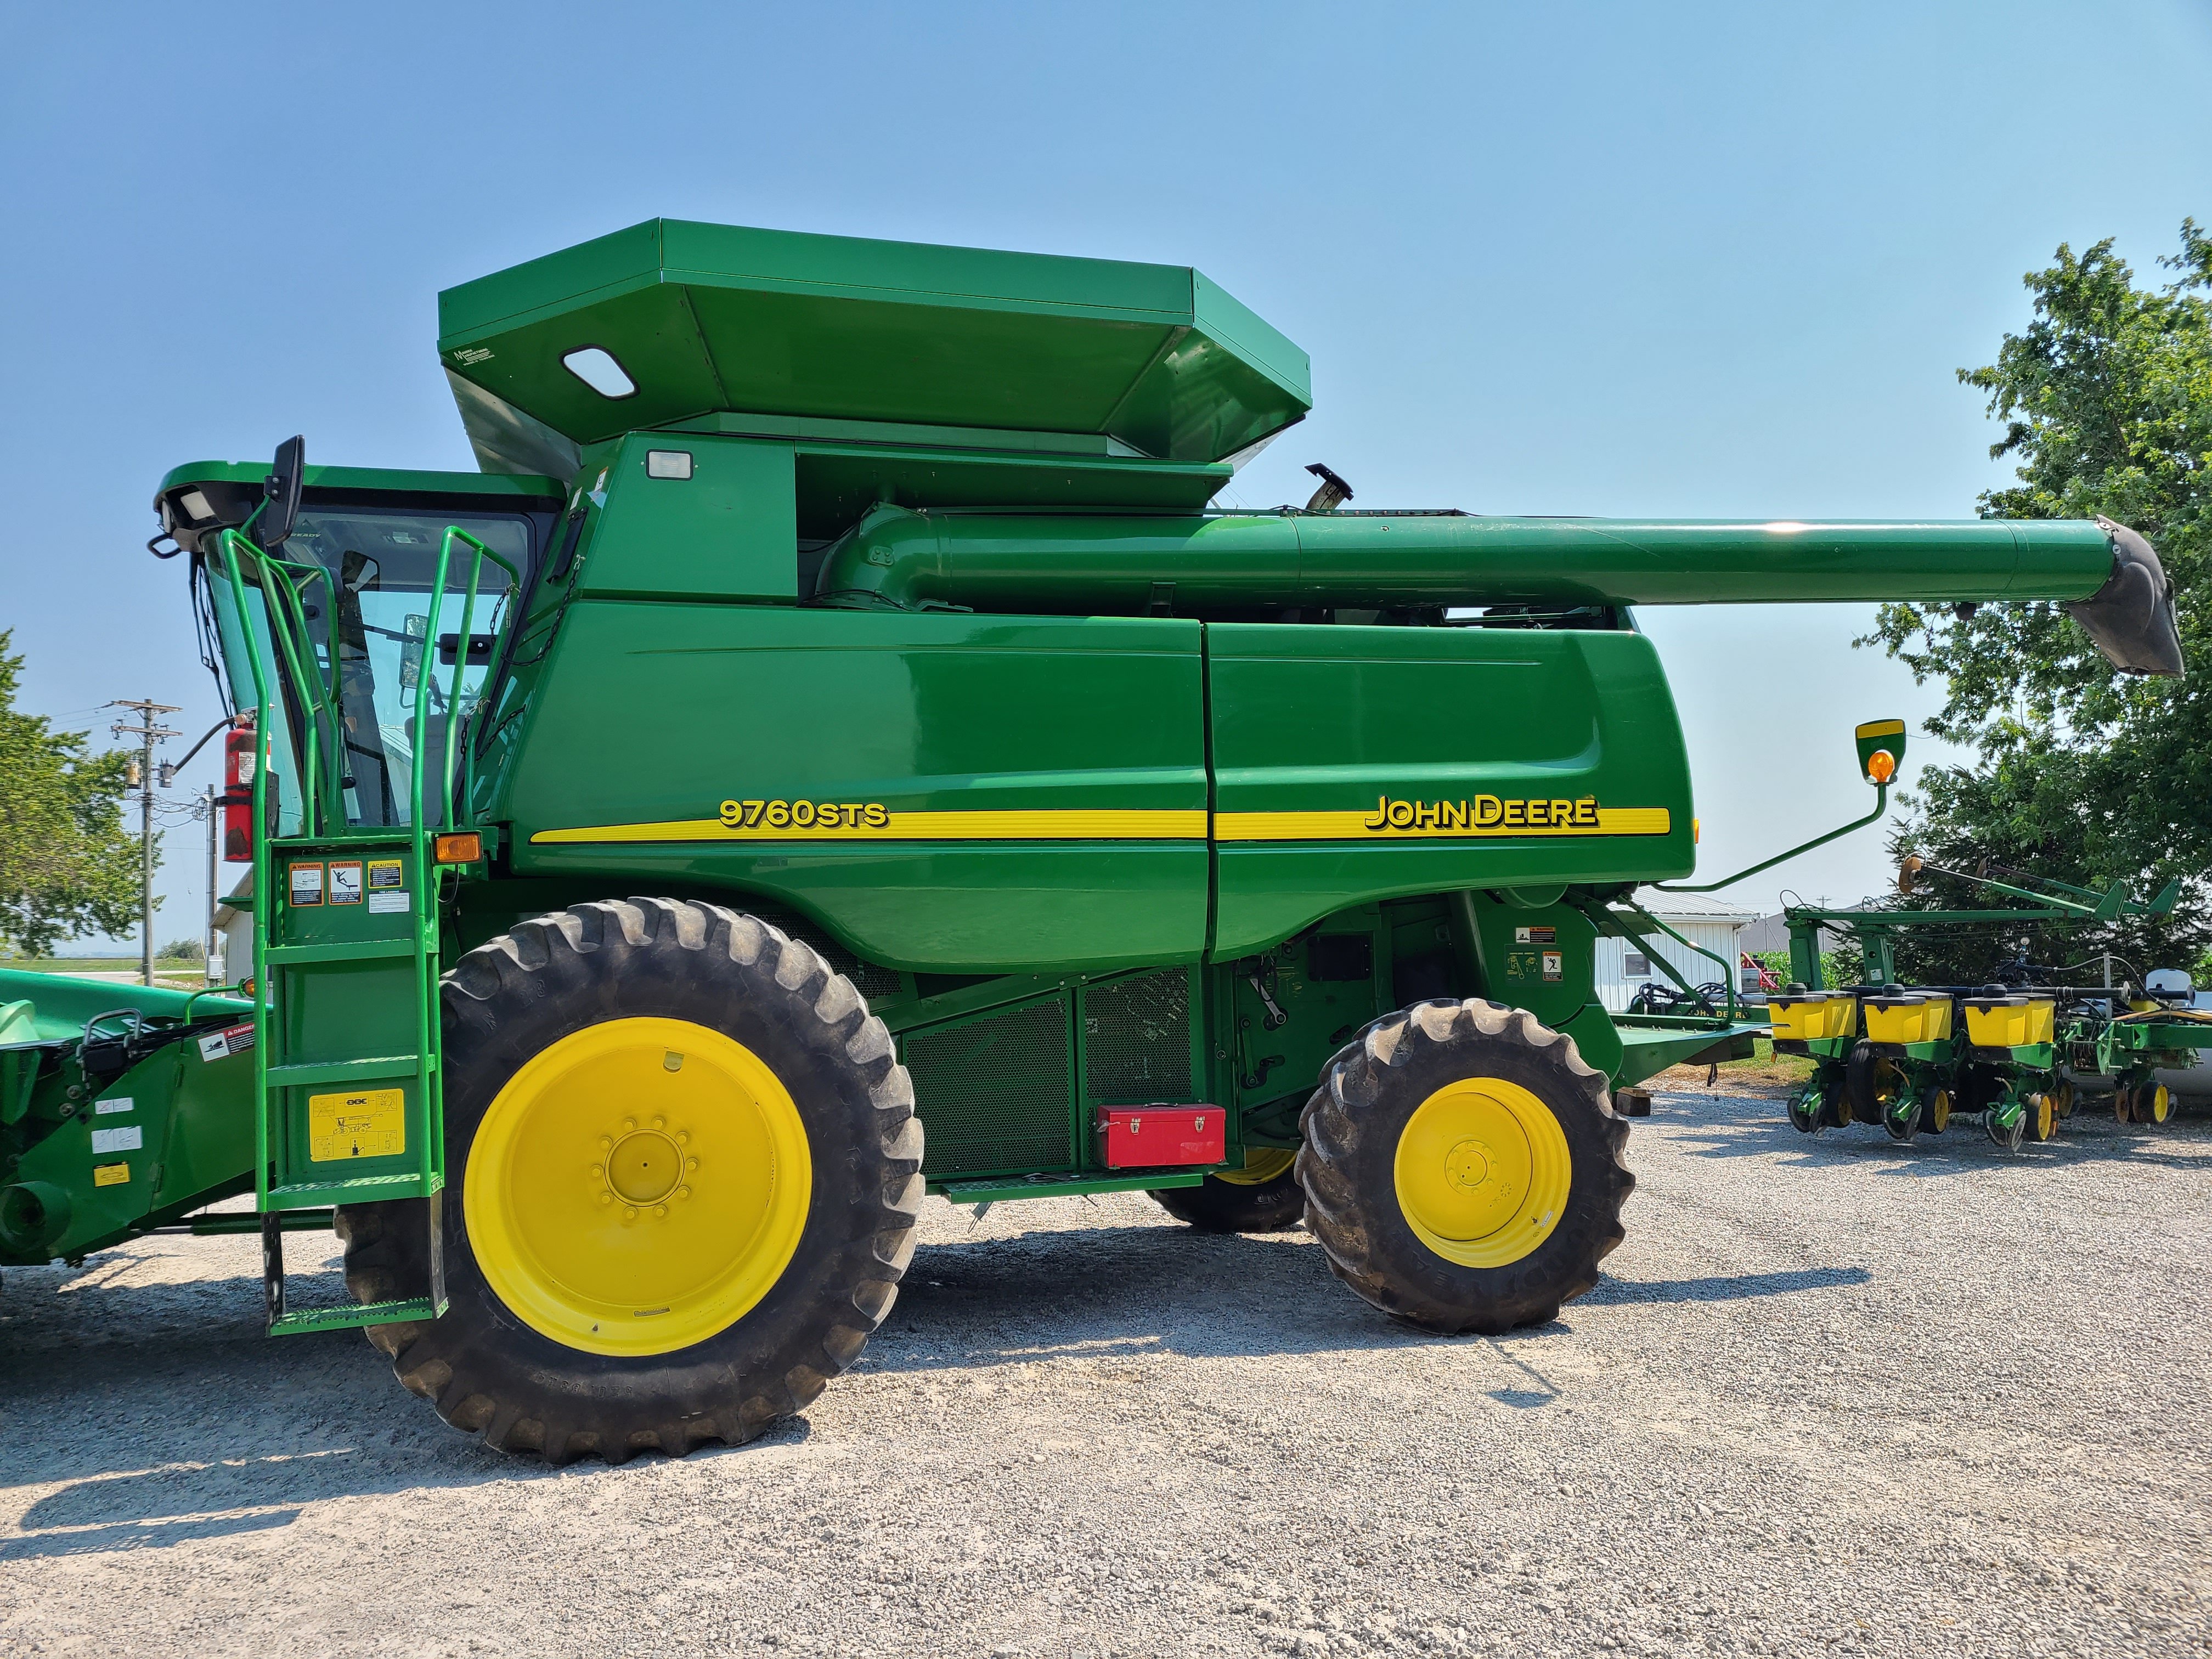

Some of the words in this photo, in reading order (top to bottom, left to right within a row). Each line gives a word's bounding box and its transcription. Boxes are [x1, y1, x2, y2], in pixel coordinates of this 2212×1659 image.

[719, 799, 890, 829] 9760STS
[1365, 795, 1470, 830] JOHN
[1474, 794, 1599, 828] DEERE
